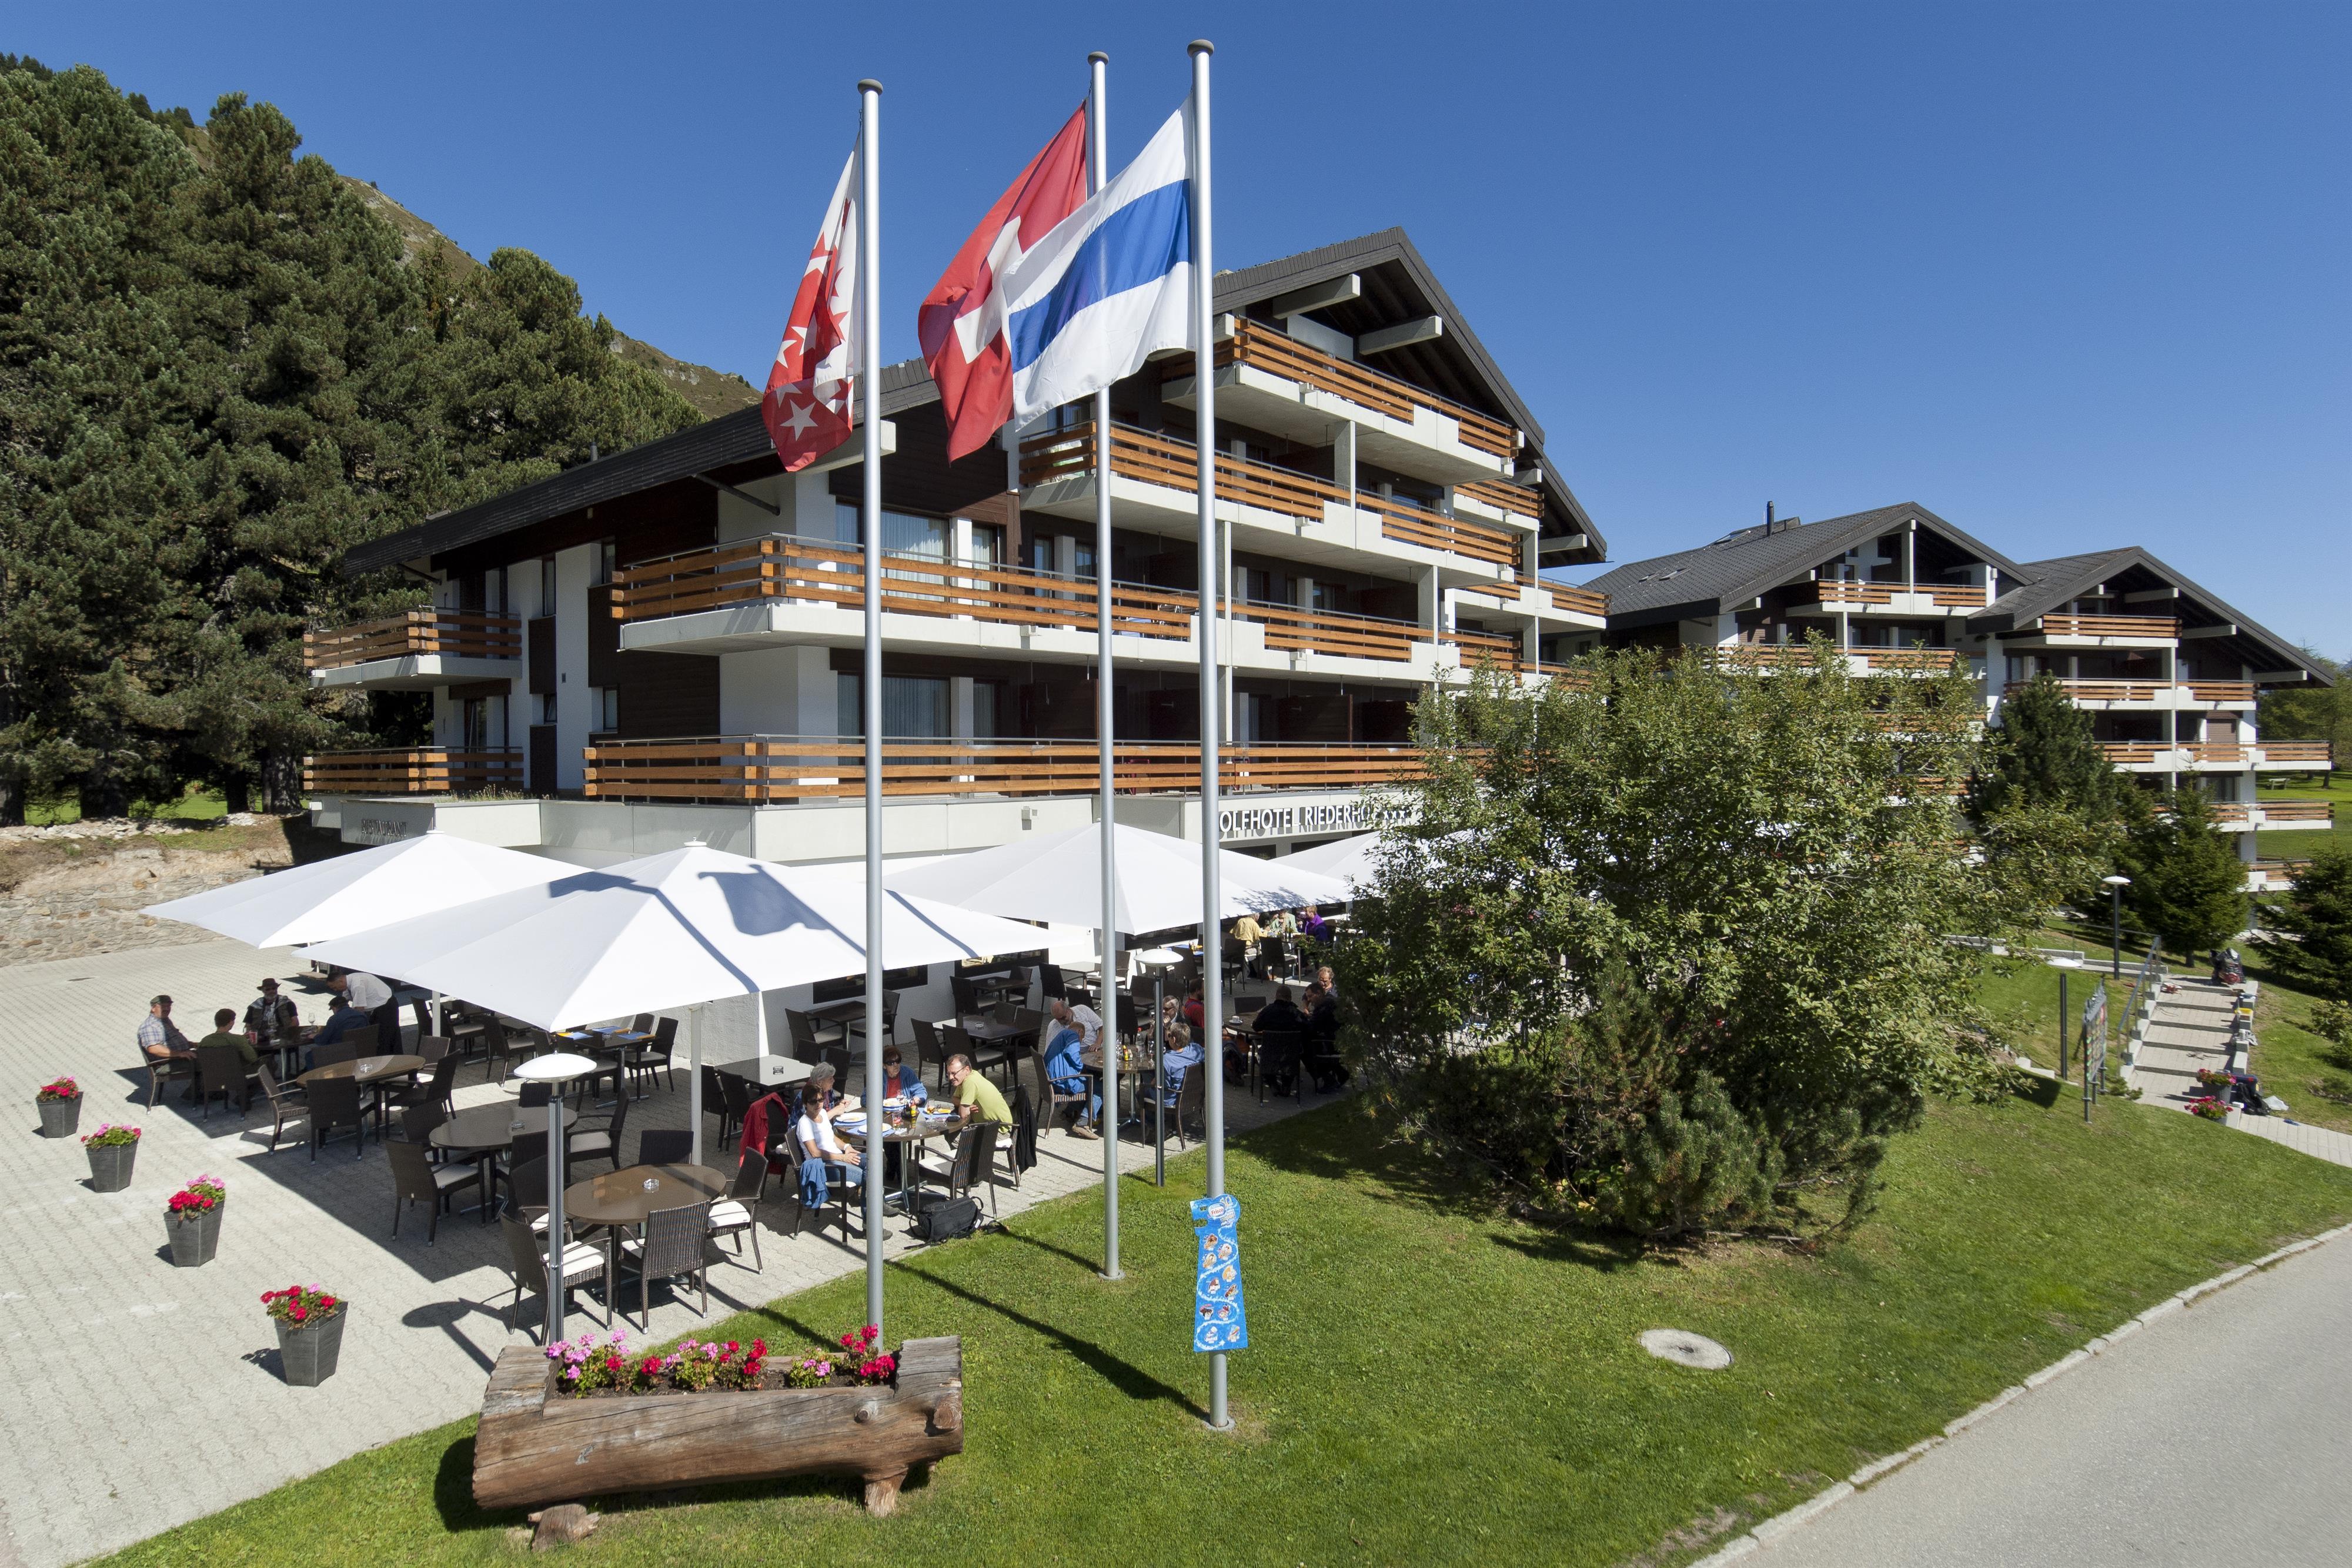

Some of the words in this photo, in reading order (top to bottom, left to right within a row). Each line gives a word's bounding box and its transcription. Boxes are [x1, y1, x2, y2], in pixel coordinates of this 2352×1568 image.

[362, 818, 407, 837] RESTAURANT
[1220, 808, 1301, 832] OLFHOTEL
[1305, 804, 1374, 825] RIEDERHO
